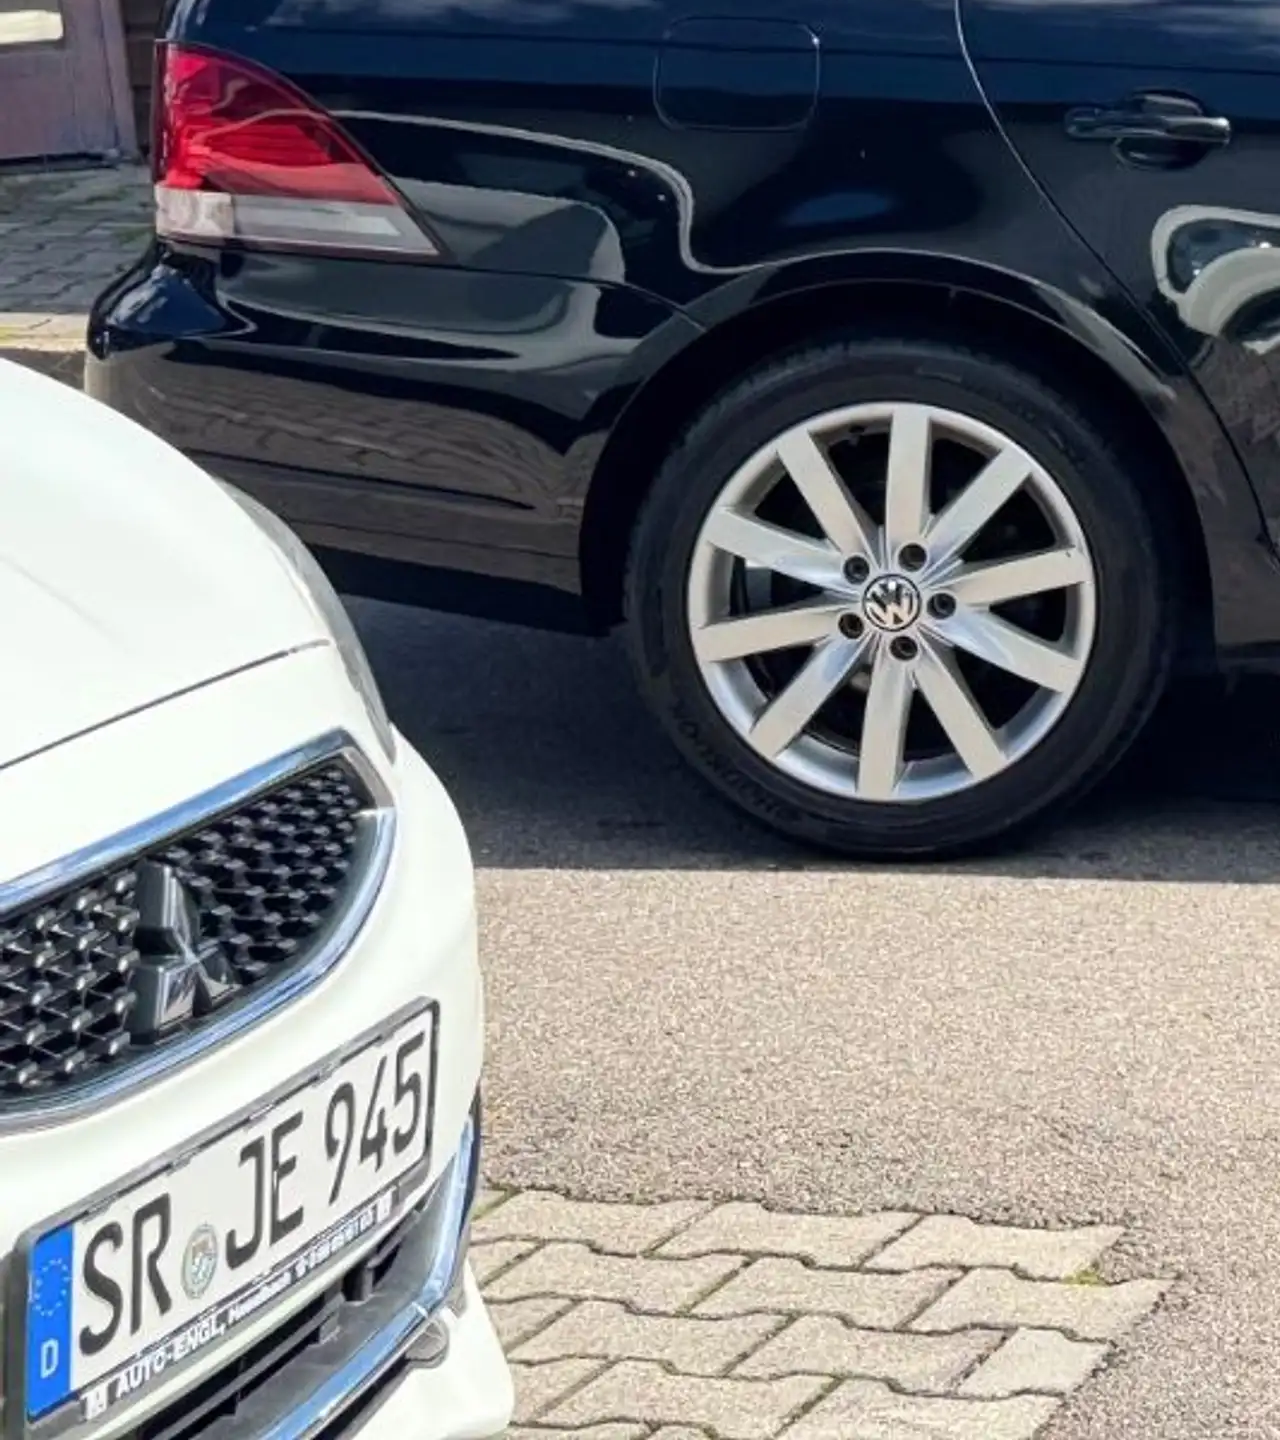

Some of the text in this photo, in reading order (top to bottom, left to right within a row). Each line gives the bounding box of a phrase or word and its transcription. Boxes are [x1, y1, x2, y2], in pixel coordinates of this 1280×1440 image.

[79, 1193, 171, 1356] SR
[226, 1110, 303, 1270] JE
[325, 1031, 424, 1205] 945
[41, 1339, 58, 1378] D
